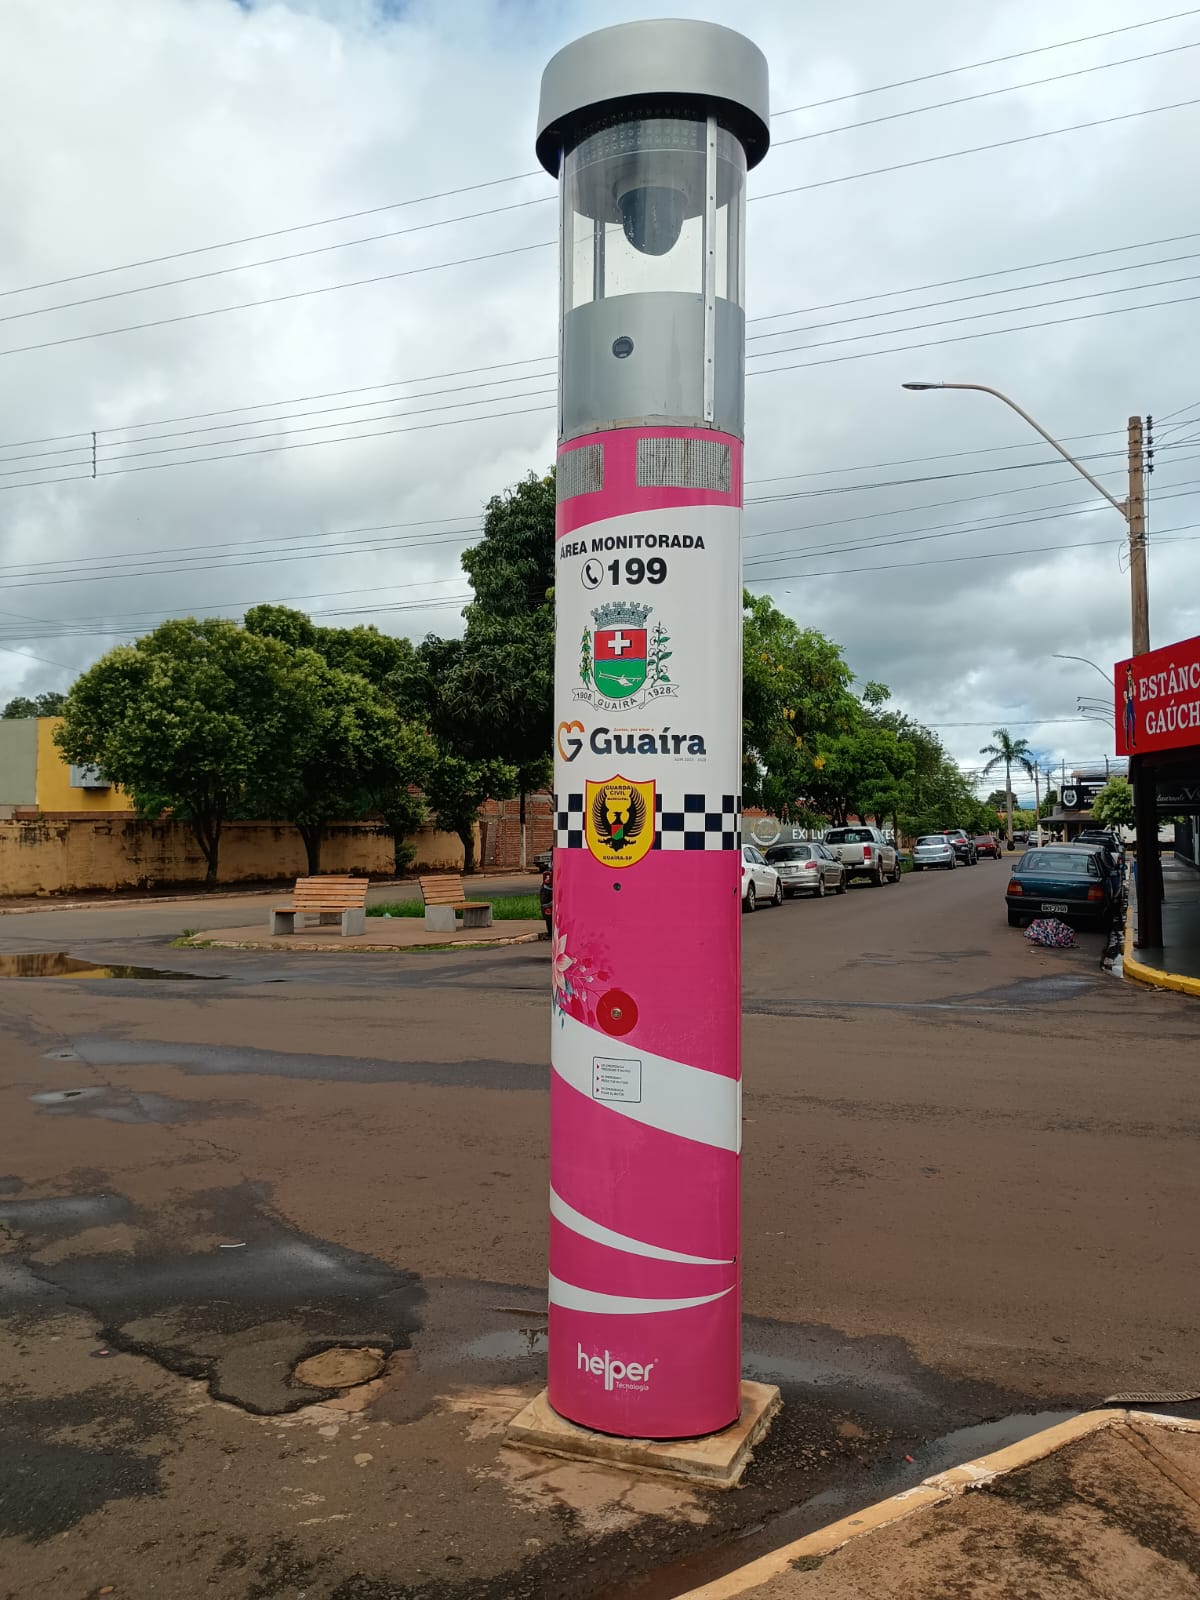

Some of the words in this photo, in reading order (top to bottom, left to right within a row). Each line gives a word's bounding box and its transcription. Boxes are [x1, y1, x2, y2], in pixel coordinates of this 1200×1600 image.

[560, 541, 587, 560] ÁREA
[592, 534, 705, 552] MONITORADA
[608, 557, 667, 585] 199
[648, 686, 672, 698] 1928
[590, 726, 706, 755] Guaíra
[577, 1342, 654, 1391] helper
[616, 1381, 649, 1391] Tecnologia
